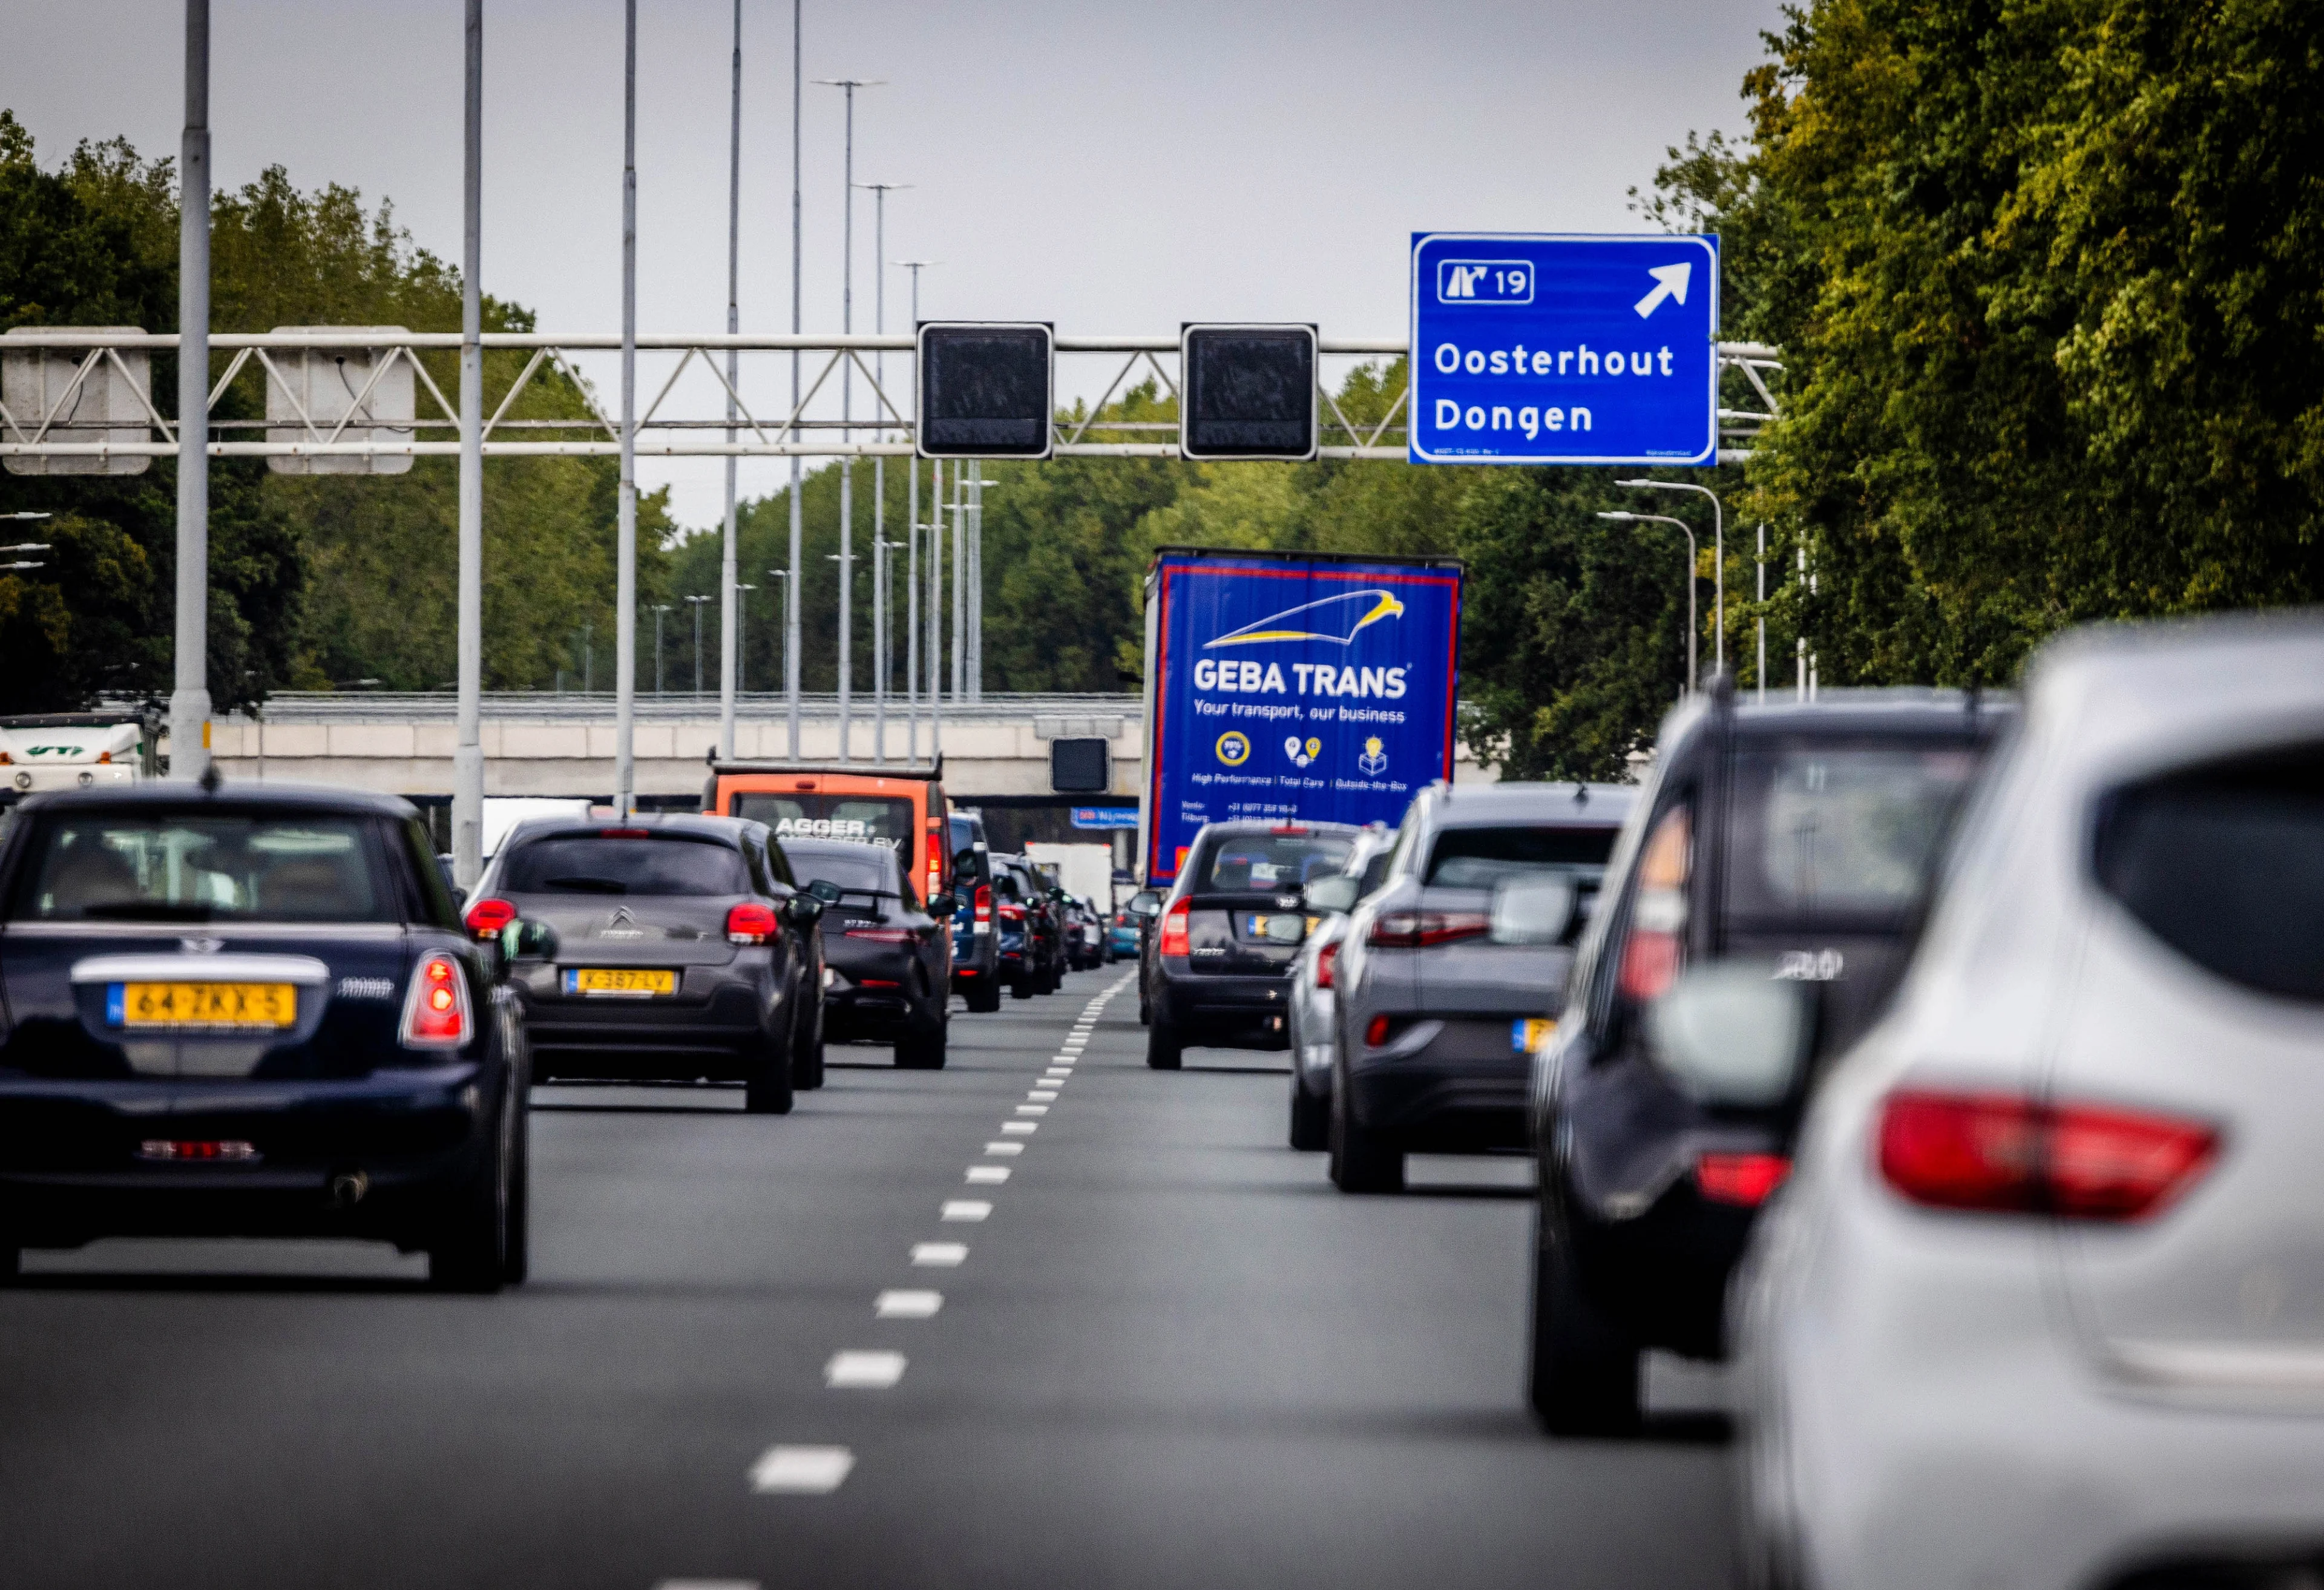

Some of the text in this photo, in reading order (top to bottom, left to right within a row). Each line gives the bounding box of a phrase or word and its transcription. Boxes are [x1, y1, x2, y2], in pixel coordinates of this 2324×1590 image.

[1495, 270, 1526, 295] 19
[1434, 343, 1673, 377] Oosterhout
[1435, 398, 1592, 441] Dongen
[1194, 659, 1408, 699] GEBA TRANS
[1194, 698, 1407, 724] Your transport, our business
[1191, 772, 1212, 786] High
[1214, 773, 1274, 786] Performance
[1279, 775, 1301, 787] Total
[1302, 777, 1325, 788] Care
